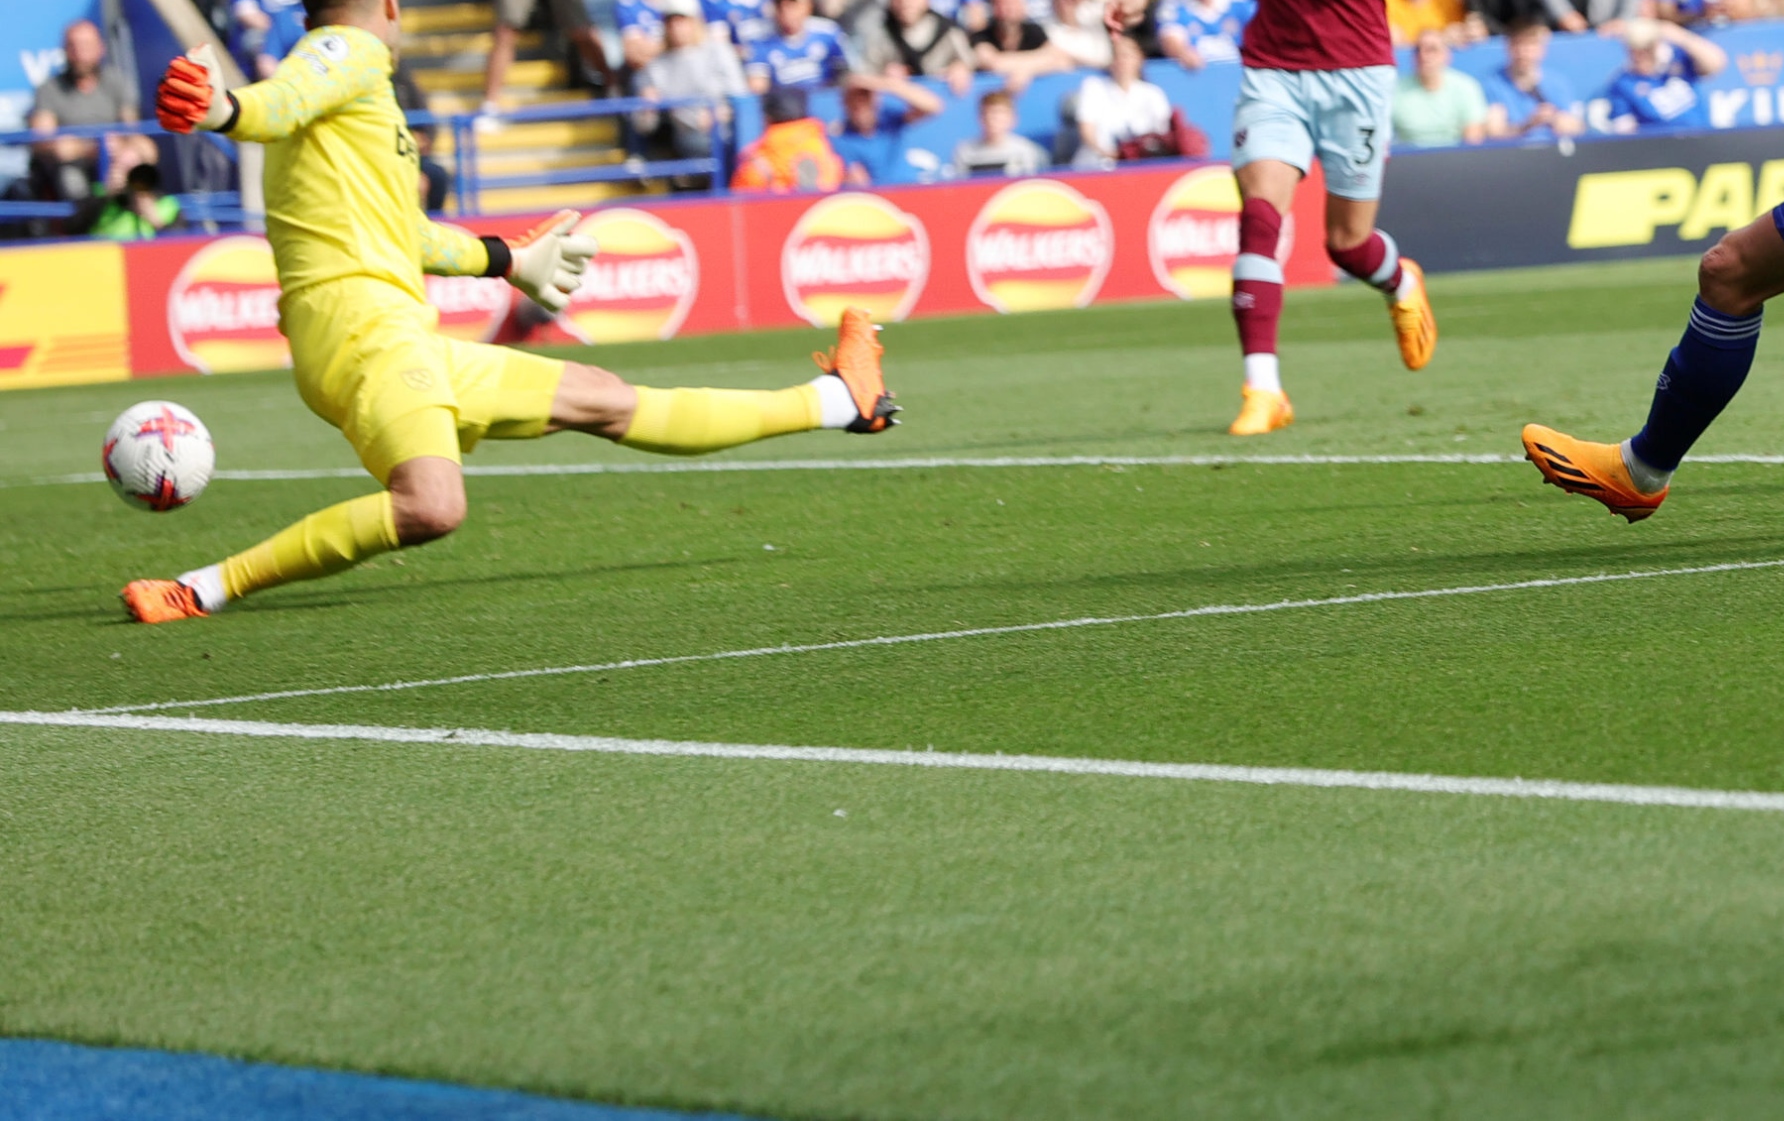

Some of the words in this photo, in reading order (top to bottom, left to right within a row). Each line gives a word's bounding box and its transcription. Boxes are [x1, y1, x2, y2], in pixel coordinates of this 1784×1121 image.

[1353, 126, 1375, 166] 3
[974, 227, 1106, 274] WALKERS
[1156, 214, 1241, 259] WALK
[573, 256, 689, 302] ALKERS
[787, 241, 920, 287] WALKERS
